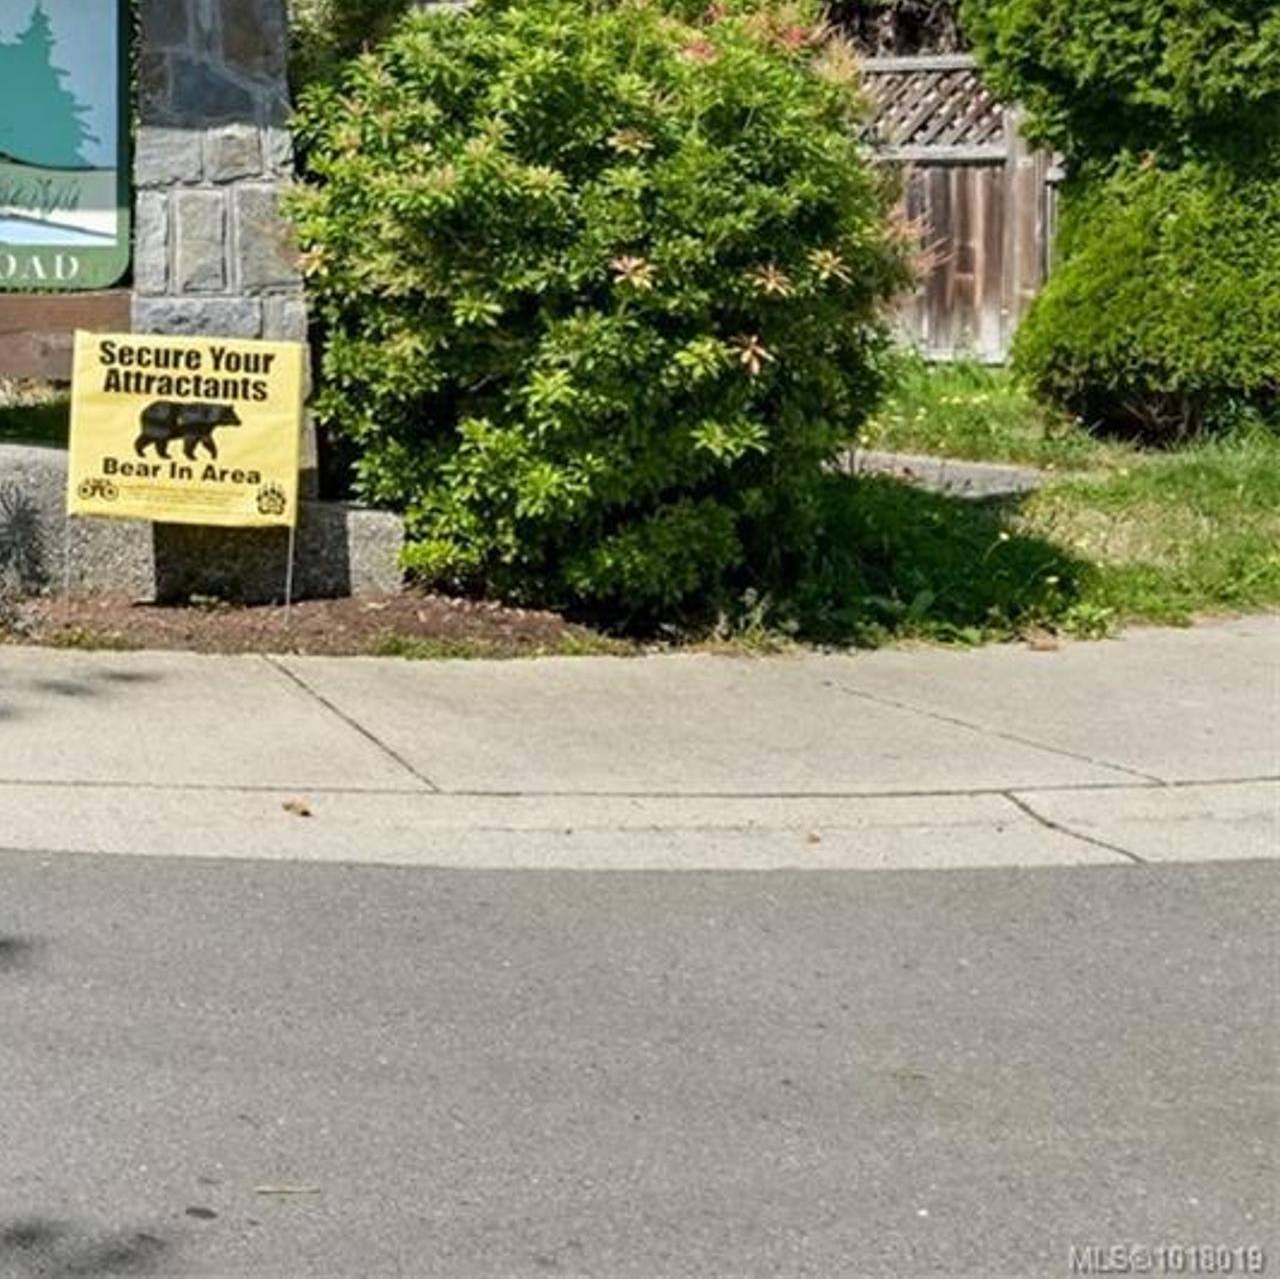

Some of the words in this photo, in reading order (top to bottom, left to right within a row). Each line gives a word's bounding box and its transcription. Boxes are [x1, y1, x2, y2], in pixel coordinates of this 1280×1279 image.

[99, 341, 201, 370] Secure
[210, 347, 275, 373] Your
[104, 369, 268, 401] Attractants
[103, 457, 161, 478] Bear
[170, 462, 193, 480] In
[201, 465, 261, 484] Area
